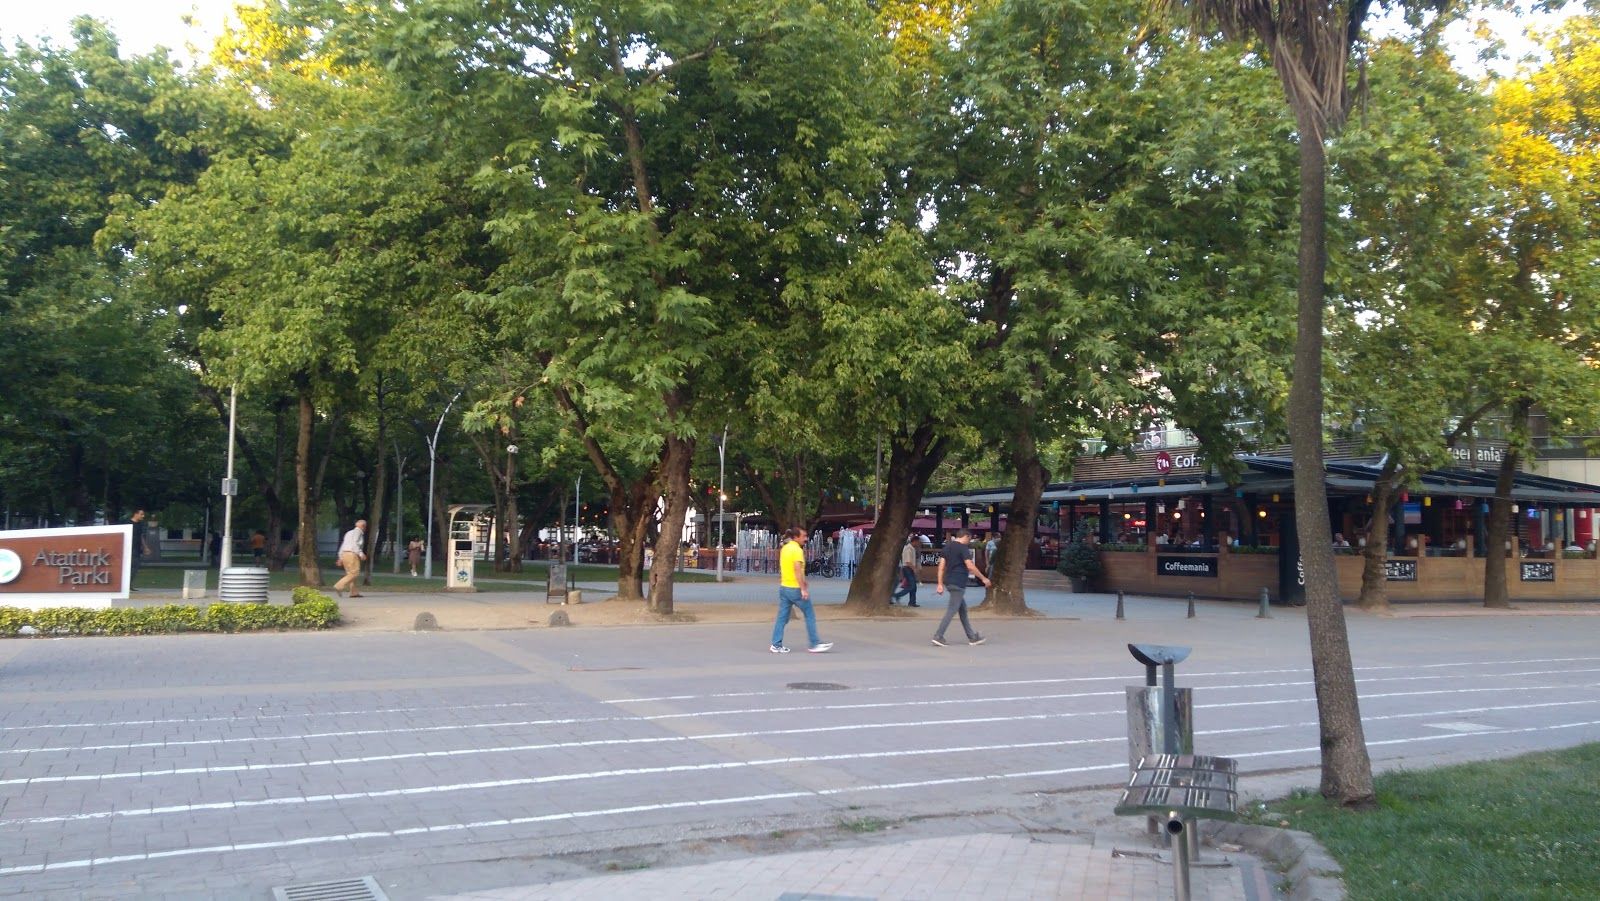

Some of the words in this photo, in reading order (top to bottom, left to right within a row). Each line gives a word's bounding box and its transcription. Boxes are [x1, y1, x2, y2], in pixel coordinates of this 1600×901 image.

[32, 547, 110, 566] Atatürk
[59, 566, 109, 584] Parkı
[1164, 561, 1210, 572] Coffeemania
